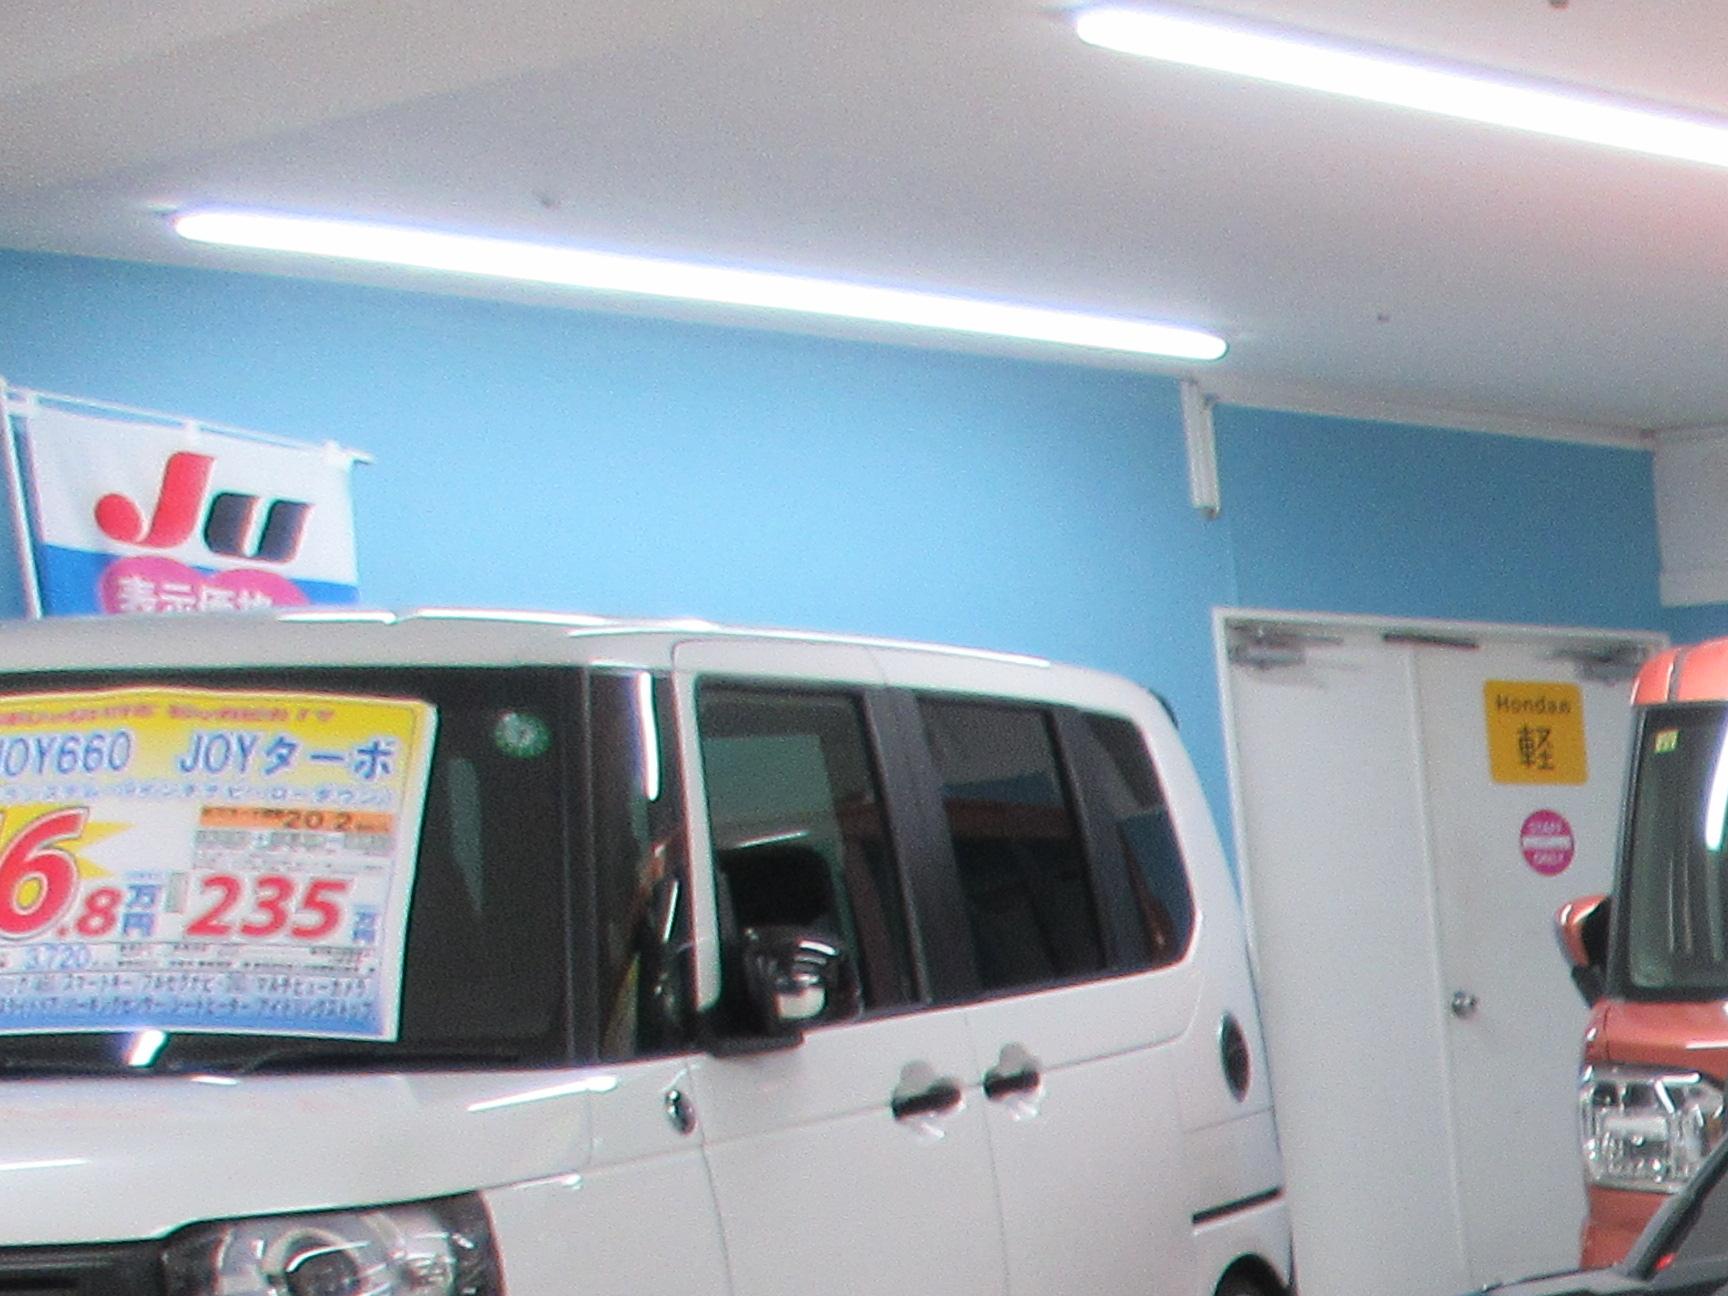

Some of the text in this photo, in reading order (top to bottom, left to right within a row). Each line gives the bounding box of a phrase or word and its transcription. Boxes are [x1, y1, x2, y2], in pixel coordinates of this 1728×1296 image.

[0, 731, 395, 781] OY660 JOYターボ
[186, 874, 350, 940] 235
